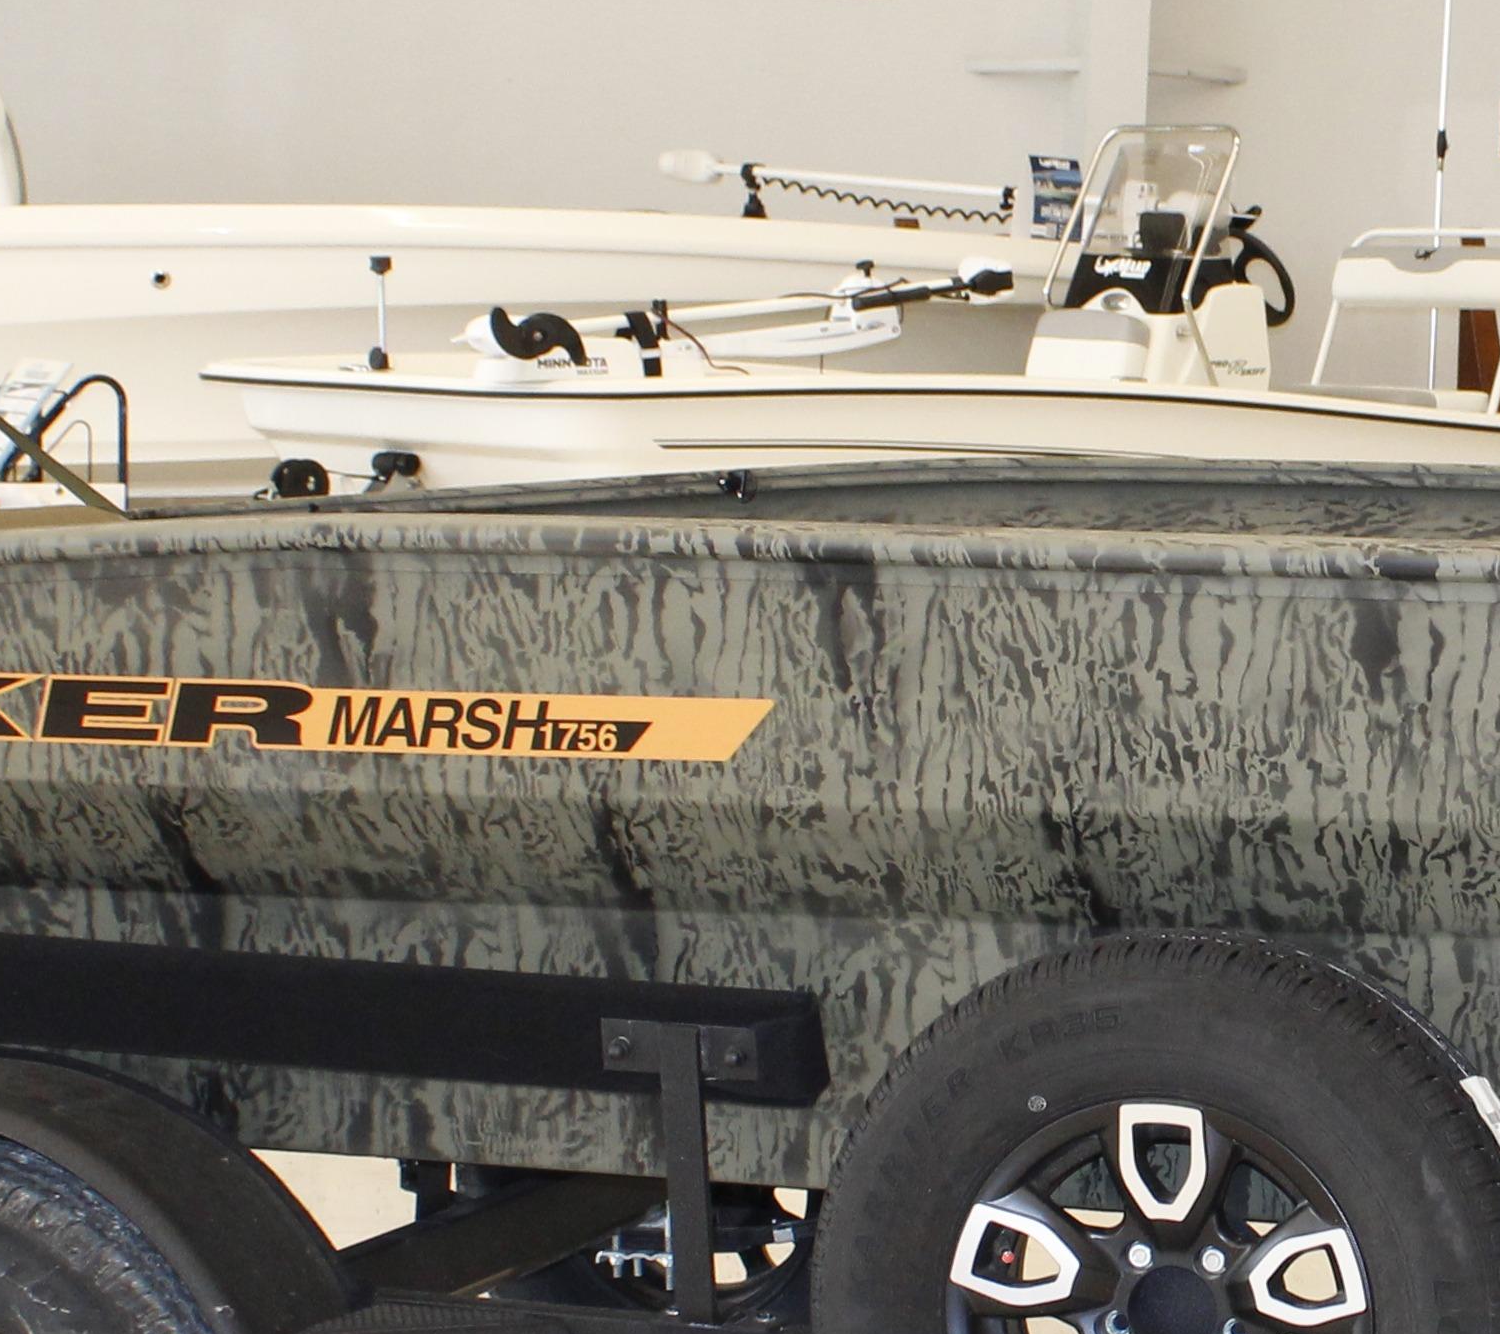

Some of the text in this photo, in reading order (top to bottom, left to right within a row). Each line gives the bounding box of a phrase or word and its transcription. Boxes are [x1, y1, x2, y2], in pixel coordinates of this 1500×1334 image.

[537, 358, 572, 368] MINN
[327, 696, 549, 750] MARSH
[539, 721, 619, 753] 1756
